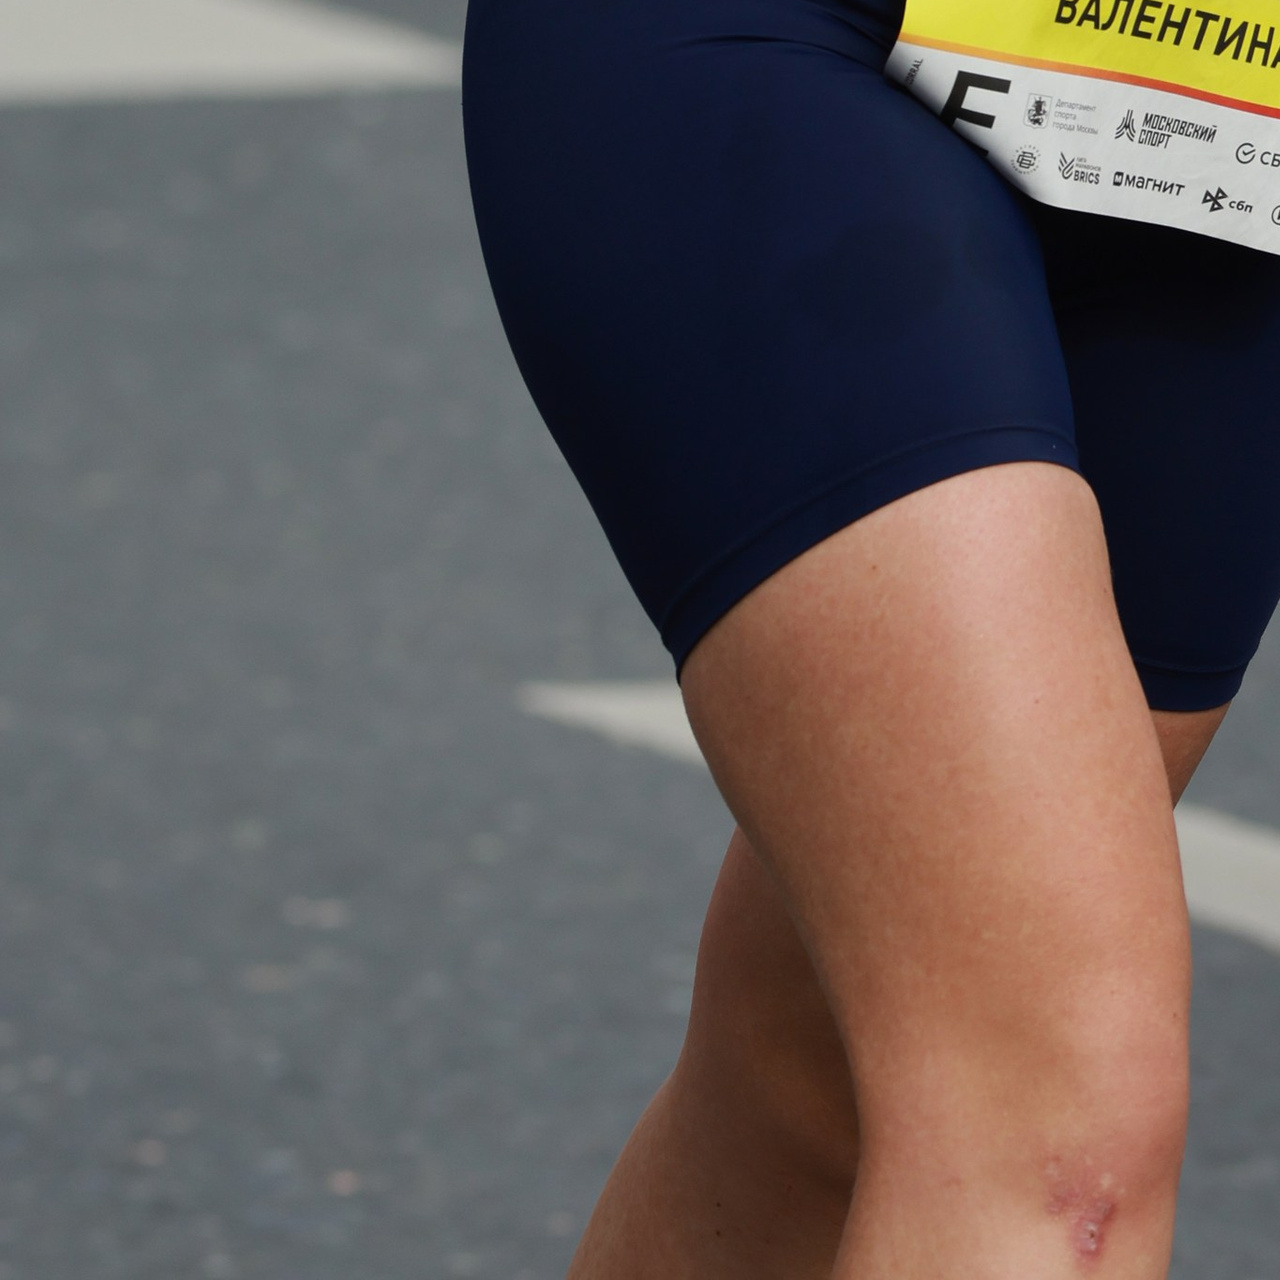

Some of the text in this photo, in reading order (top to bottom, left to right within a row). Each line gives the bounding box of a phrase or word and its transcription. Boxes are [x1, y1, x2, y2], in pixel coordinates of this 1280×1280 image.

[1137, 128, 1173, 149] СПОРТ
[1141, 112, 1218, 144] МОСКОВСКИЙ
[1073, 169, 1100, 185] BRICS
